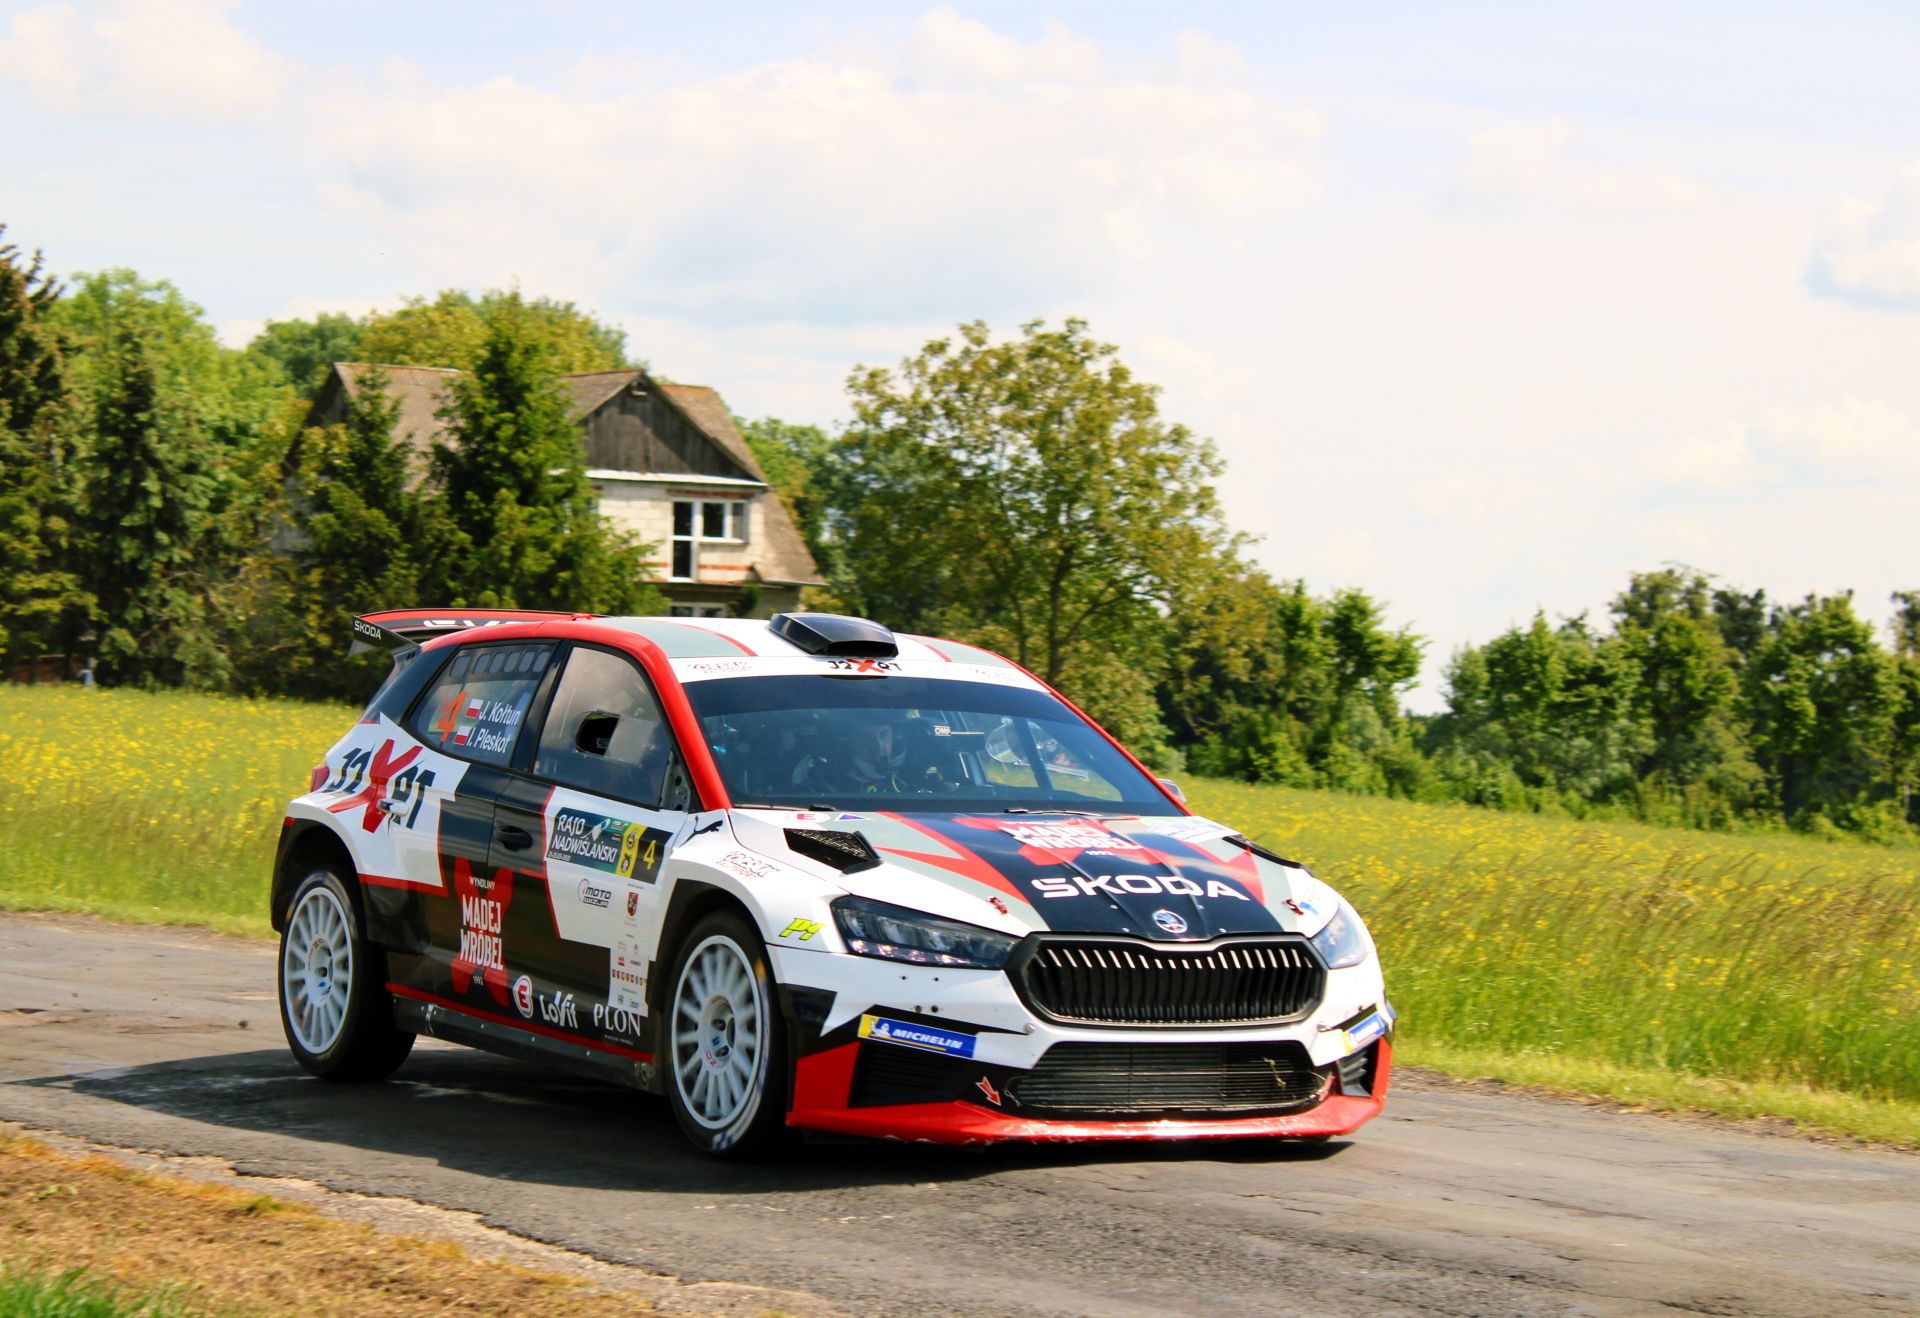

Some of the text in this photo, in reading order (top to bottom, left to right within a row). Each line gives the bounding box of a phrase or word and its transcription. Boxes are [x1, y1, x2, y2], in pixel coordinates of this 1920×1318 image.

[437, 690, 468, 743] 4
[478, 700, 491, 720] J.
[473, 728, 512, 753] Pleskot
[551, 835, 618, 863] NADWIŚLAŃSKI
[643, 840, 656, 870] 4
[462, 894, 502, 934] MADEJ
[460, 929, 504, 971] WRÓBEL
[593, 1003, 641, 1037] PLON
[892, 1028, 963, 1049] MICHELIN
